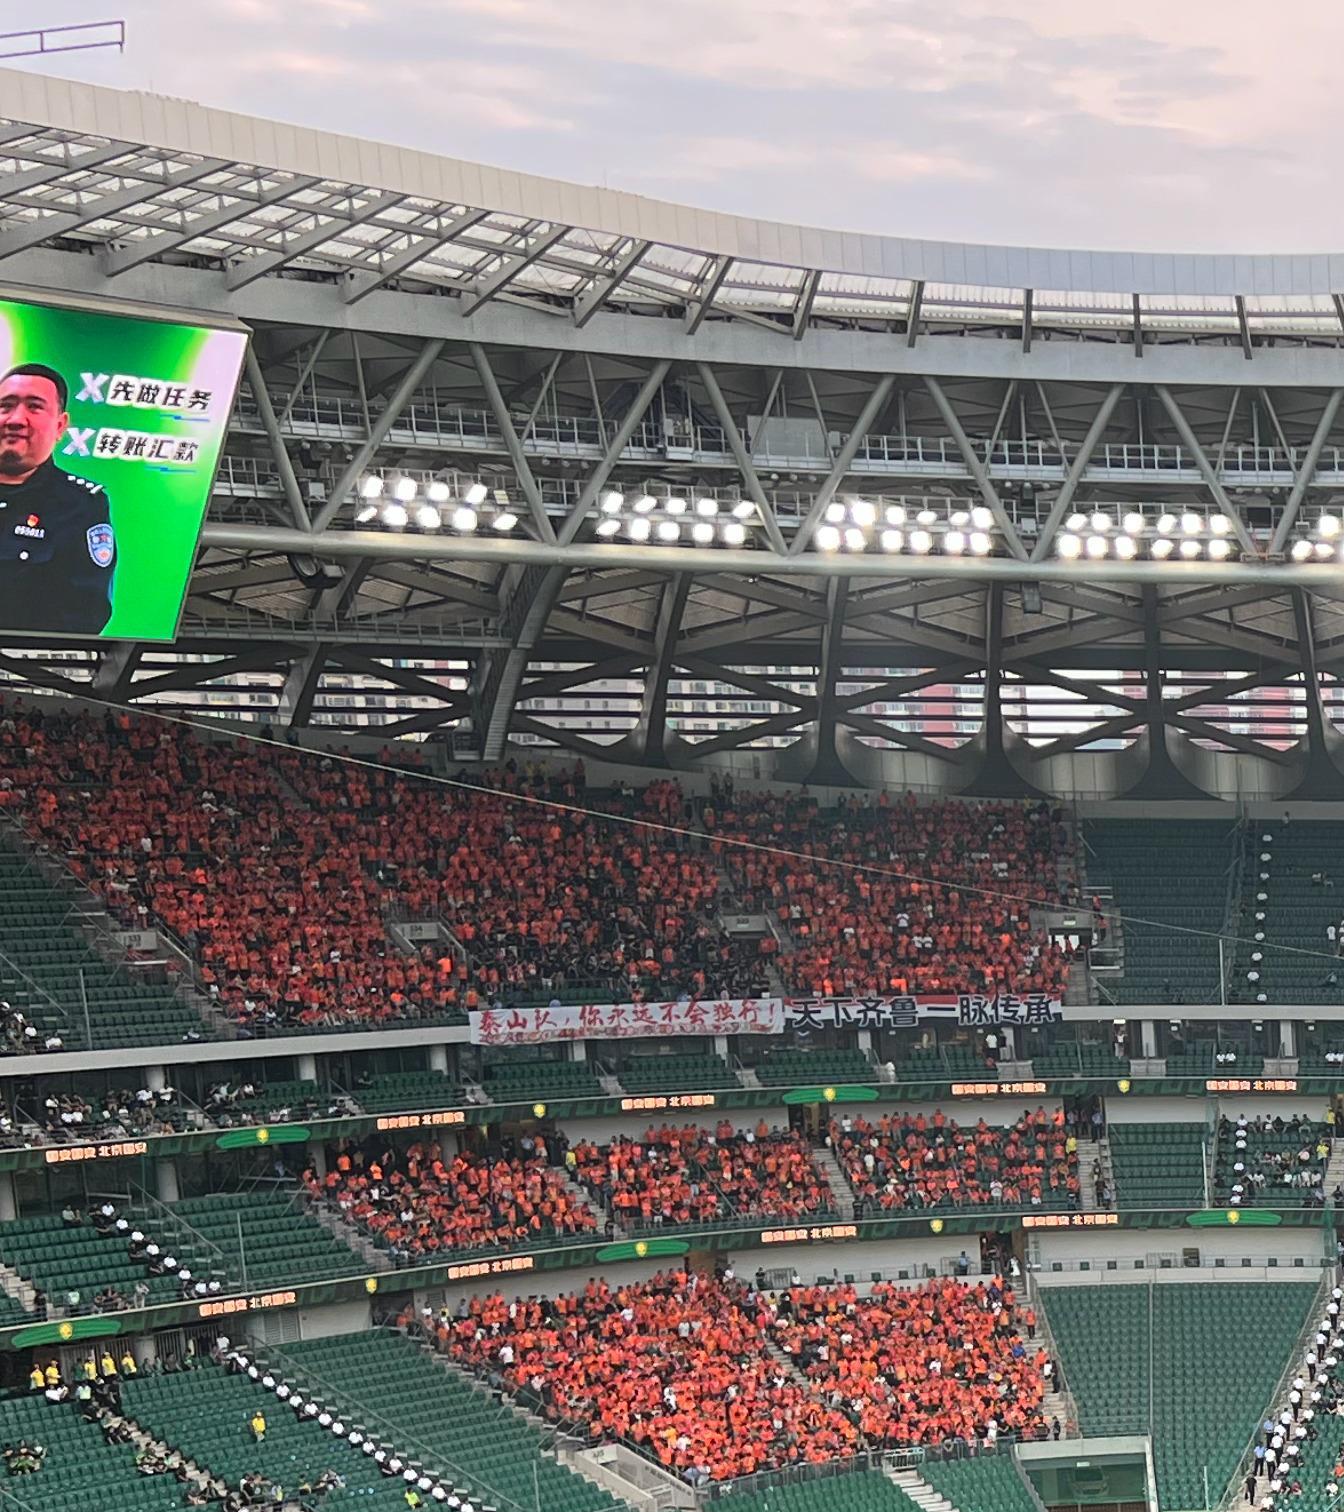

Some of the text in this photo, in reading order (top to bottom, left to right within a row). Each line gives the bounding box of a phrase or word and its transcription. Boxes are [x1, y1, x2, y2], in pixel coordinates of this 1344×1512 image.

[110, 378, 213, 412] 先做任务
[96, 430, 200, 464] 转账汇款
